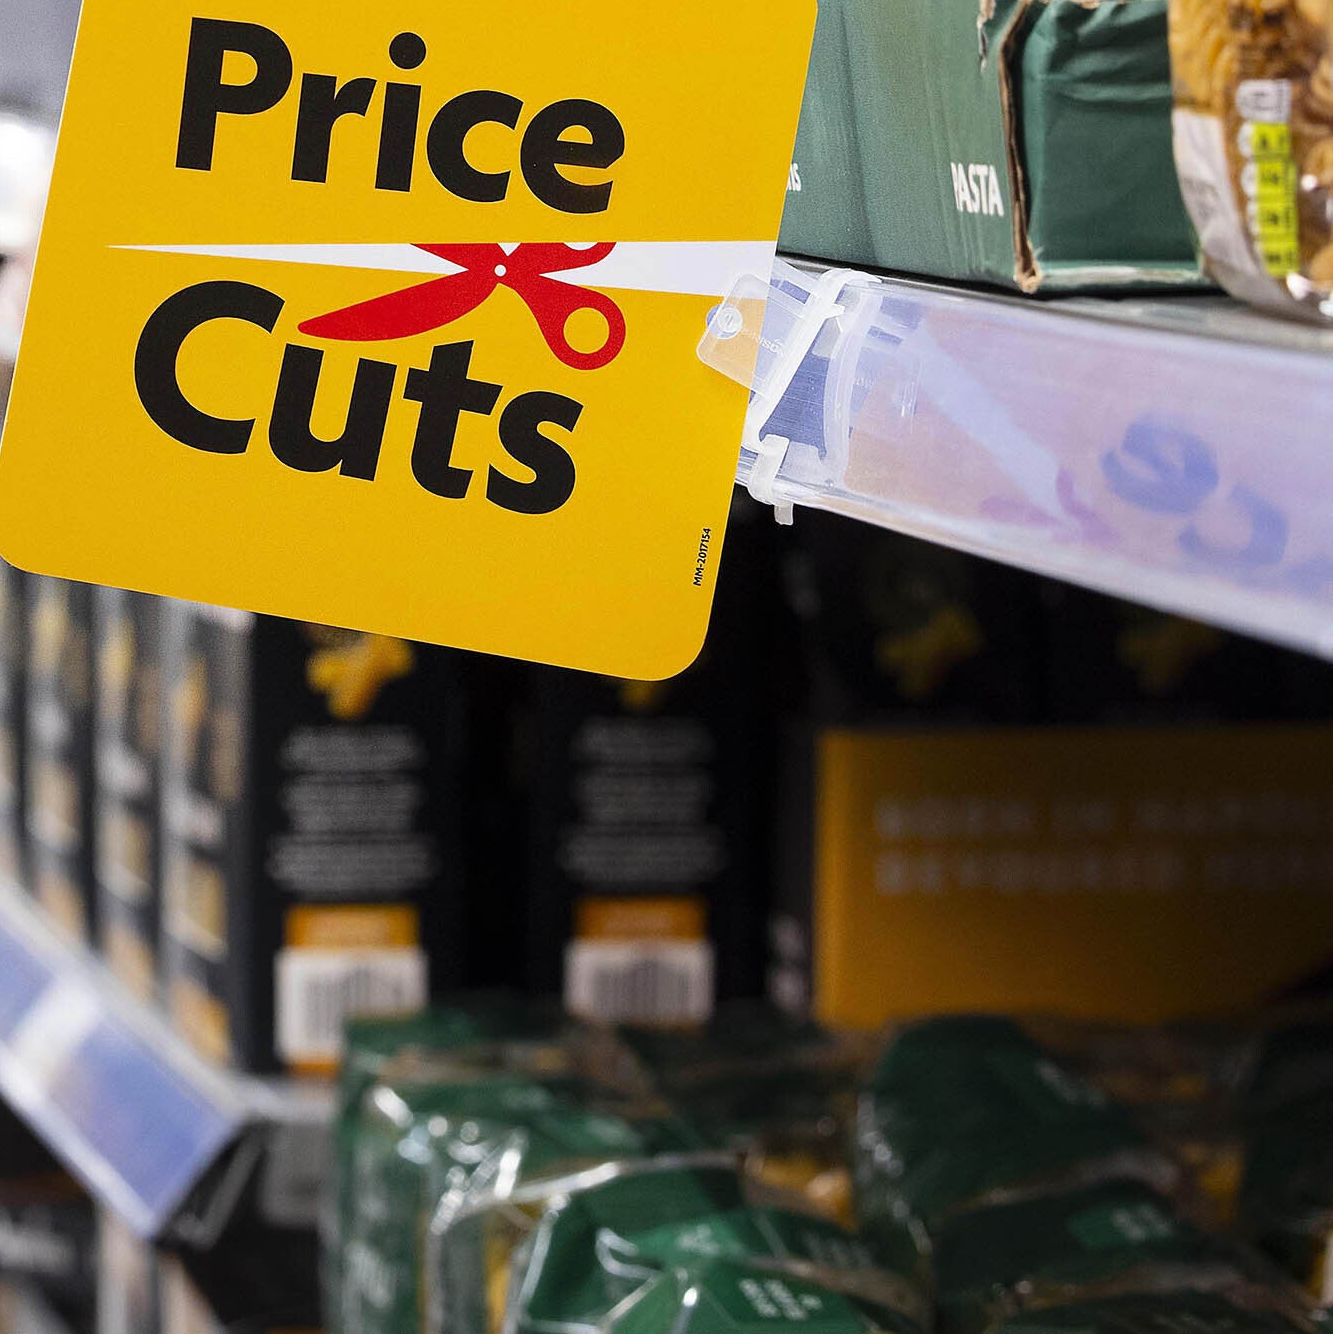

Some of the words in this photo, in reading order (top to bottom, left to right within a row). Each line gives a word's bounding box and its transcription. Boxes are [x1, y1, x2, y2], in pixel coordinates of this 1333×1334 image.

[175, 16, 626, 215] Price
[134, 279, 584, 516] Cuts
[693, 528, 711, 586] MM-2017154
